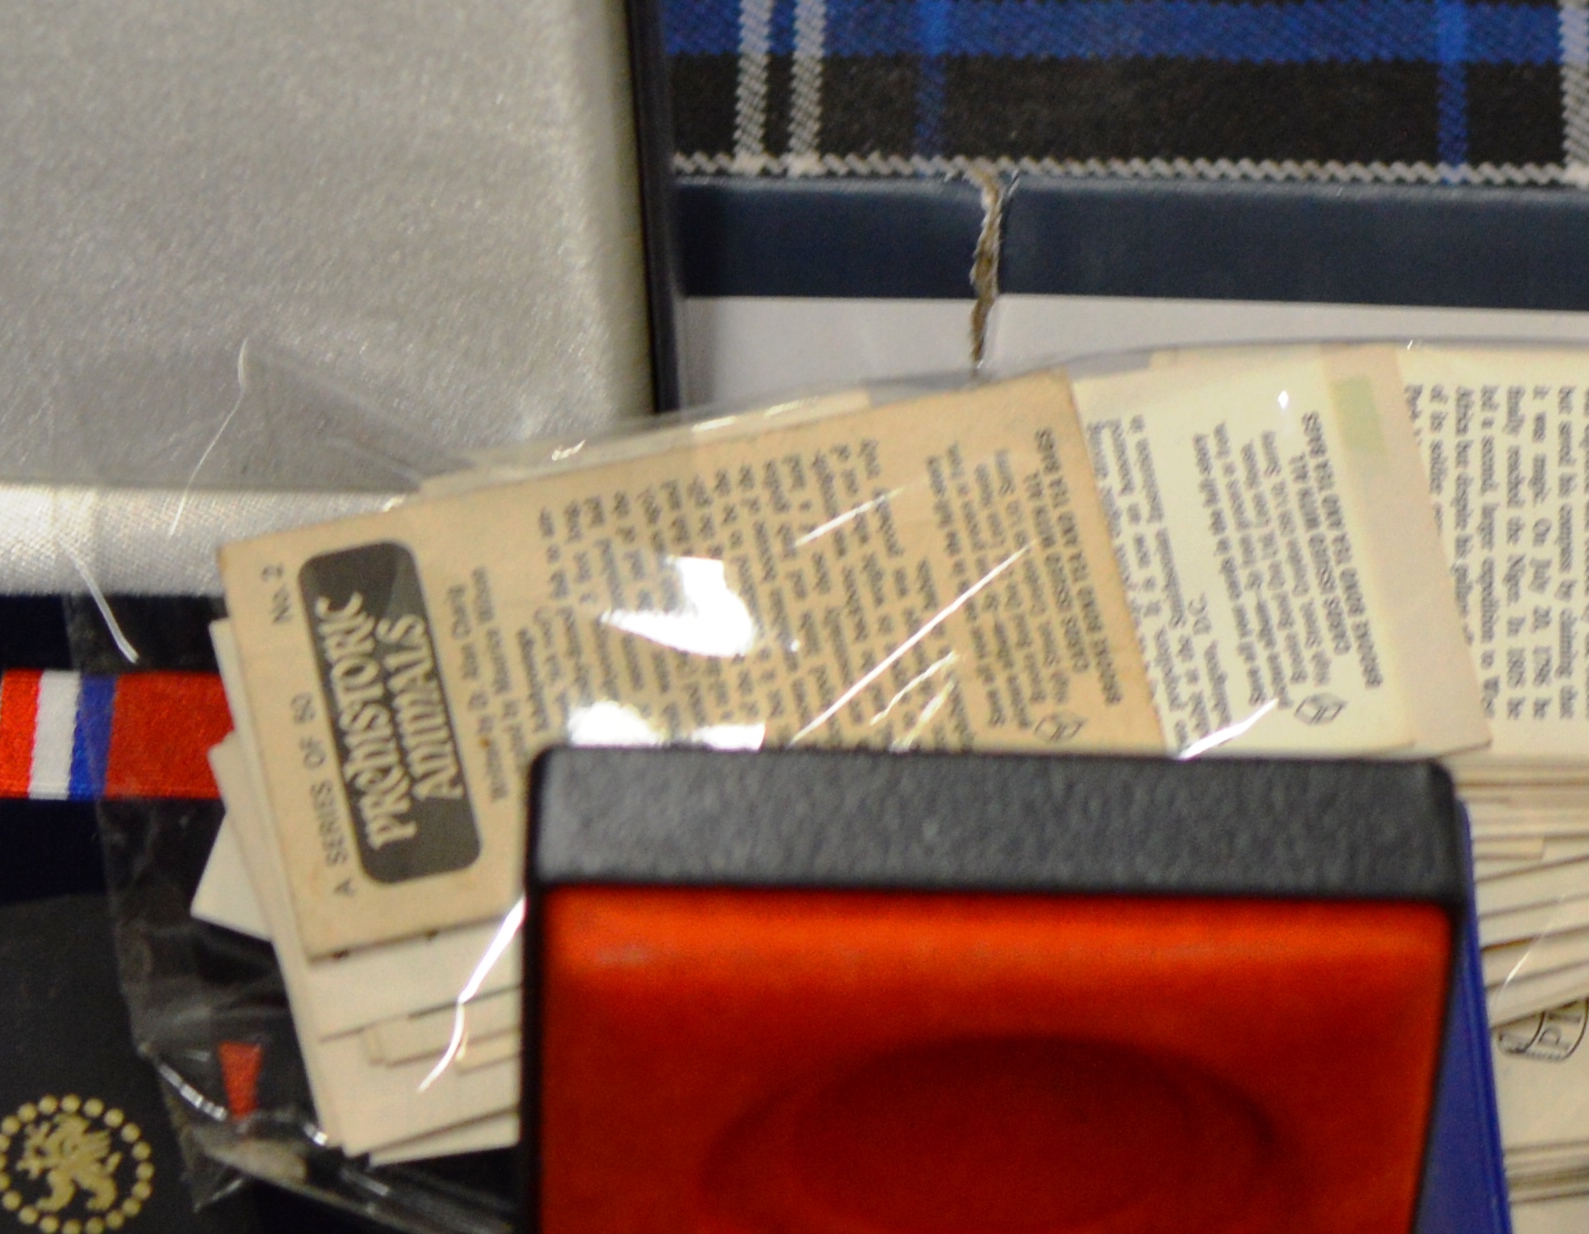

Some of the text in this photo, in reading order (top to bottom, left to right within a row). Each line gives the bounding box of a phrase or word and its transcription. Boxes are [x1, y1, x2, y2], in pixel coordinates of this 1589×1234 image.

[258, 561, 285, 582] 2
[1031, 425, 1124, 707] BROOKE BOND TEA AND TEA BAGS
[1286, 451, 1354, 657] CARDS ISSUED WITH ALL
[1299, 409, 1385, 690] BROOKE BOND TEA AND TEA BAGS
[1042, 550, 1075, 613] ISSUED
[1059, 614, 1092, 674] CARDS
[287, 691, 318, 725] 50
[298, 733, 328, 771] OF
[306, 778, 349, 869] SERIES
[330, 877, 355, 899] A
